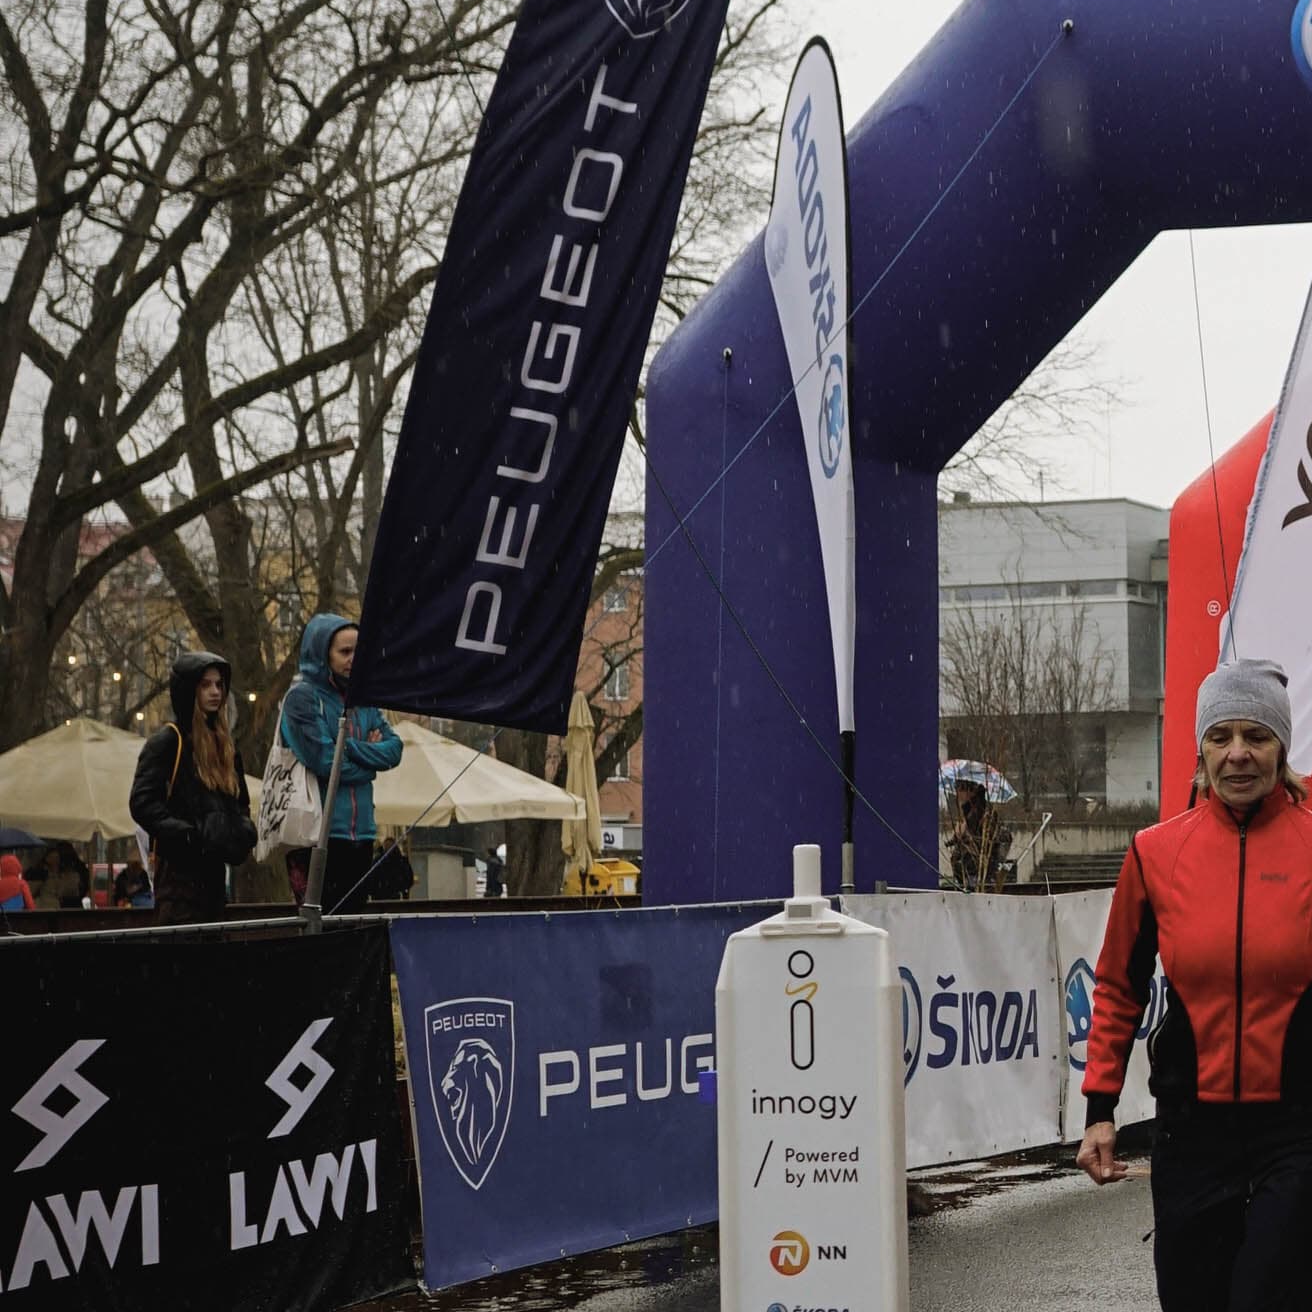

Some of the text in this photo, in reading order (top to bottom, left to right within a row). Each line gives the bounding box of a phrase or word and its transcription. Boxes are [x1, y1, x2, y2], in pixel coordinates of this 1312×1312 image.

[455, 64, 638, 655] PEUGEOT
[432, 1013, 506, 1035] PEUGEOT
[926, 974, 1039, 1069] ŠKODA
[539, 1033, 714, 1117] PEUG
[752, 1089, 858, 1119] innogy
[785, 1147, 859, 1163] Powered
[785, 1169, 858, 1188] by MVM
[229, 1138, 378, 1251] LAWI
[0, 1183, 160, 1293] AWI
[817, 1246, 847, 1260] NN
